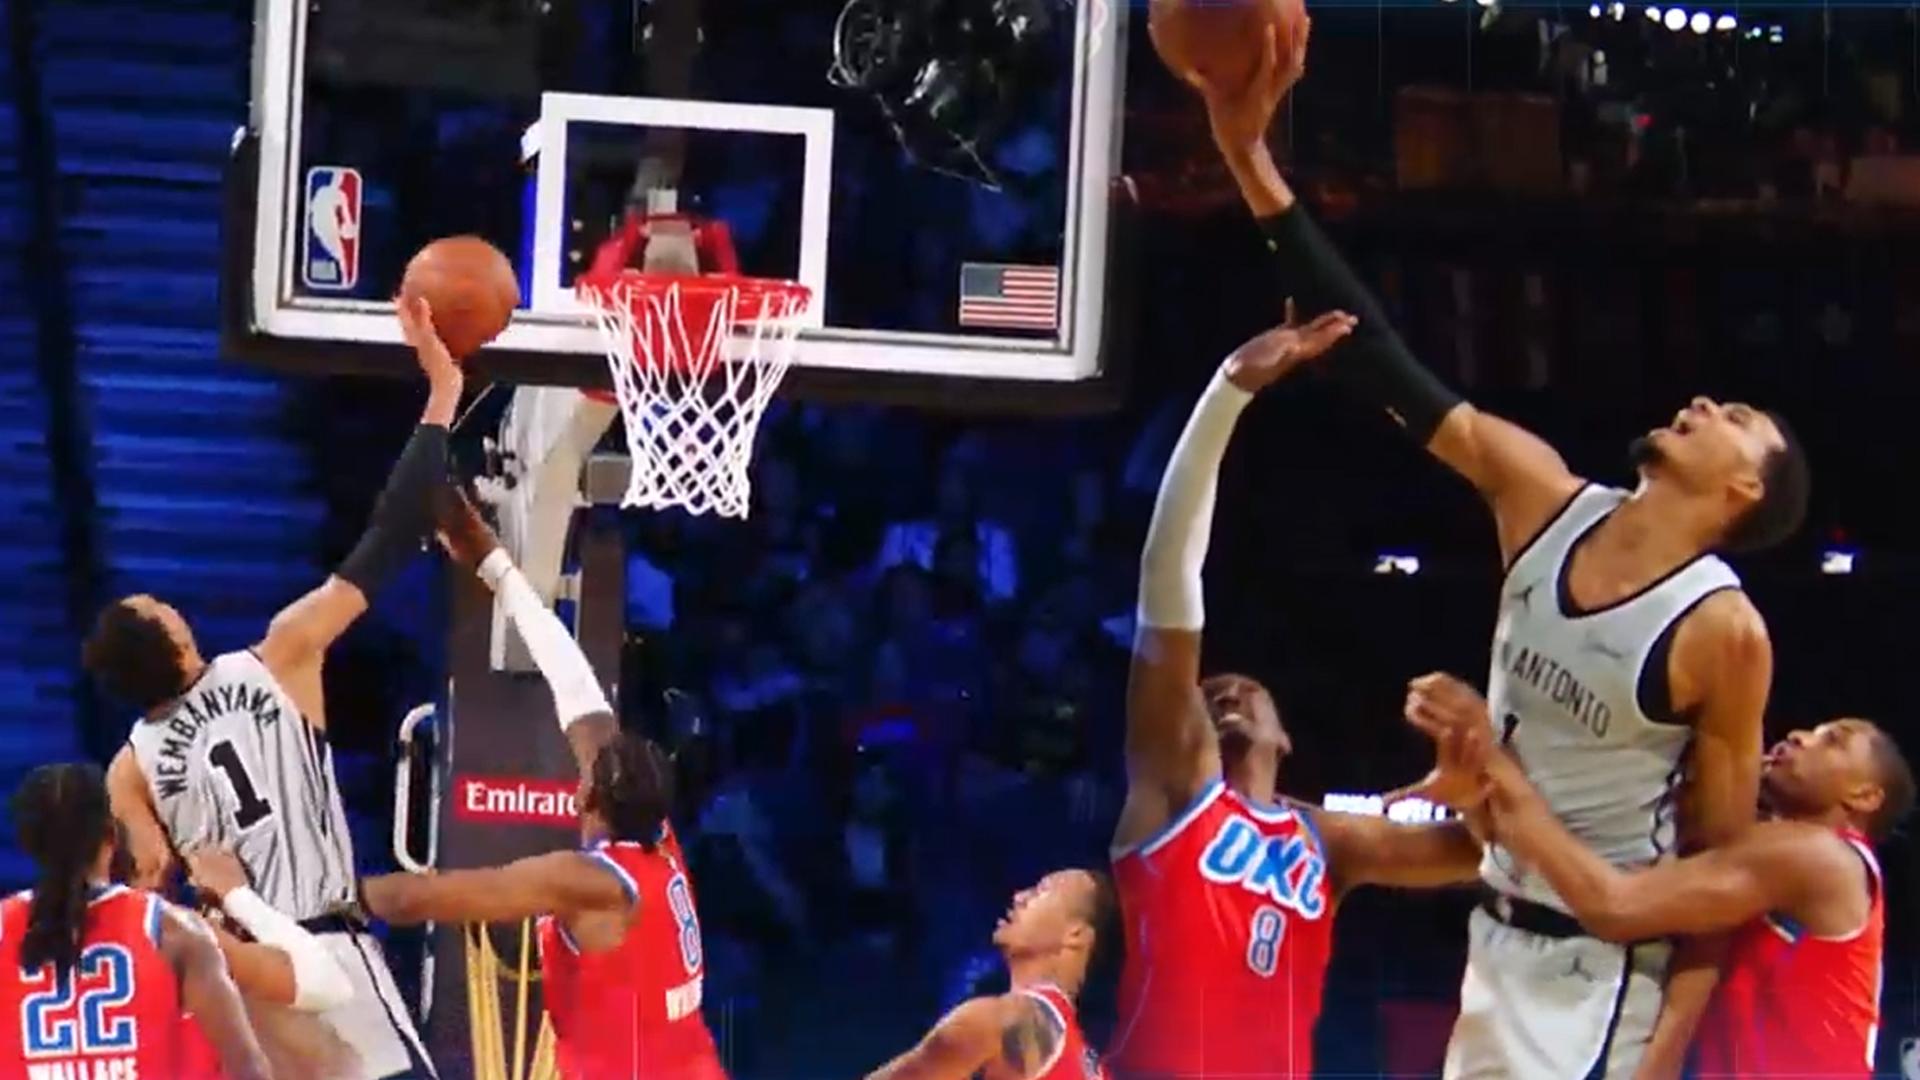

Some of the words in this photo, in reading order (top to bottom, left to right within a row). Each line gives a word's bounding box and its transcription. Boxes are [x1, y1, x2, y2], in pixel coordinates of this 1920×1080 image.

[1511, 648, 1611, 738] ANTONIO
[209, 739, 272, 830] 1
[665, 872, 701, 975] 8
[1246, 904, 1287, 977] 8
[20, 942, 137, 1058] 22
